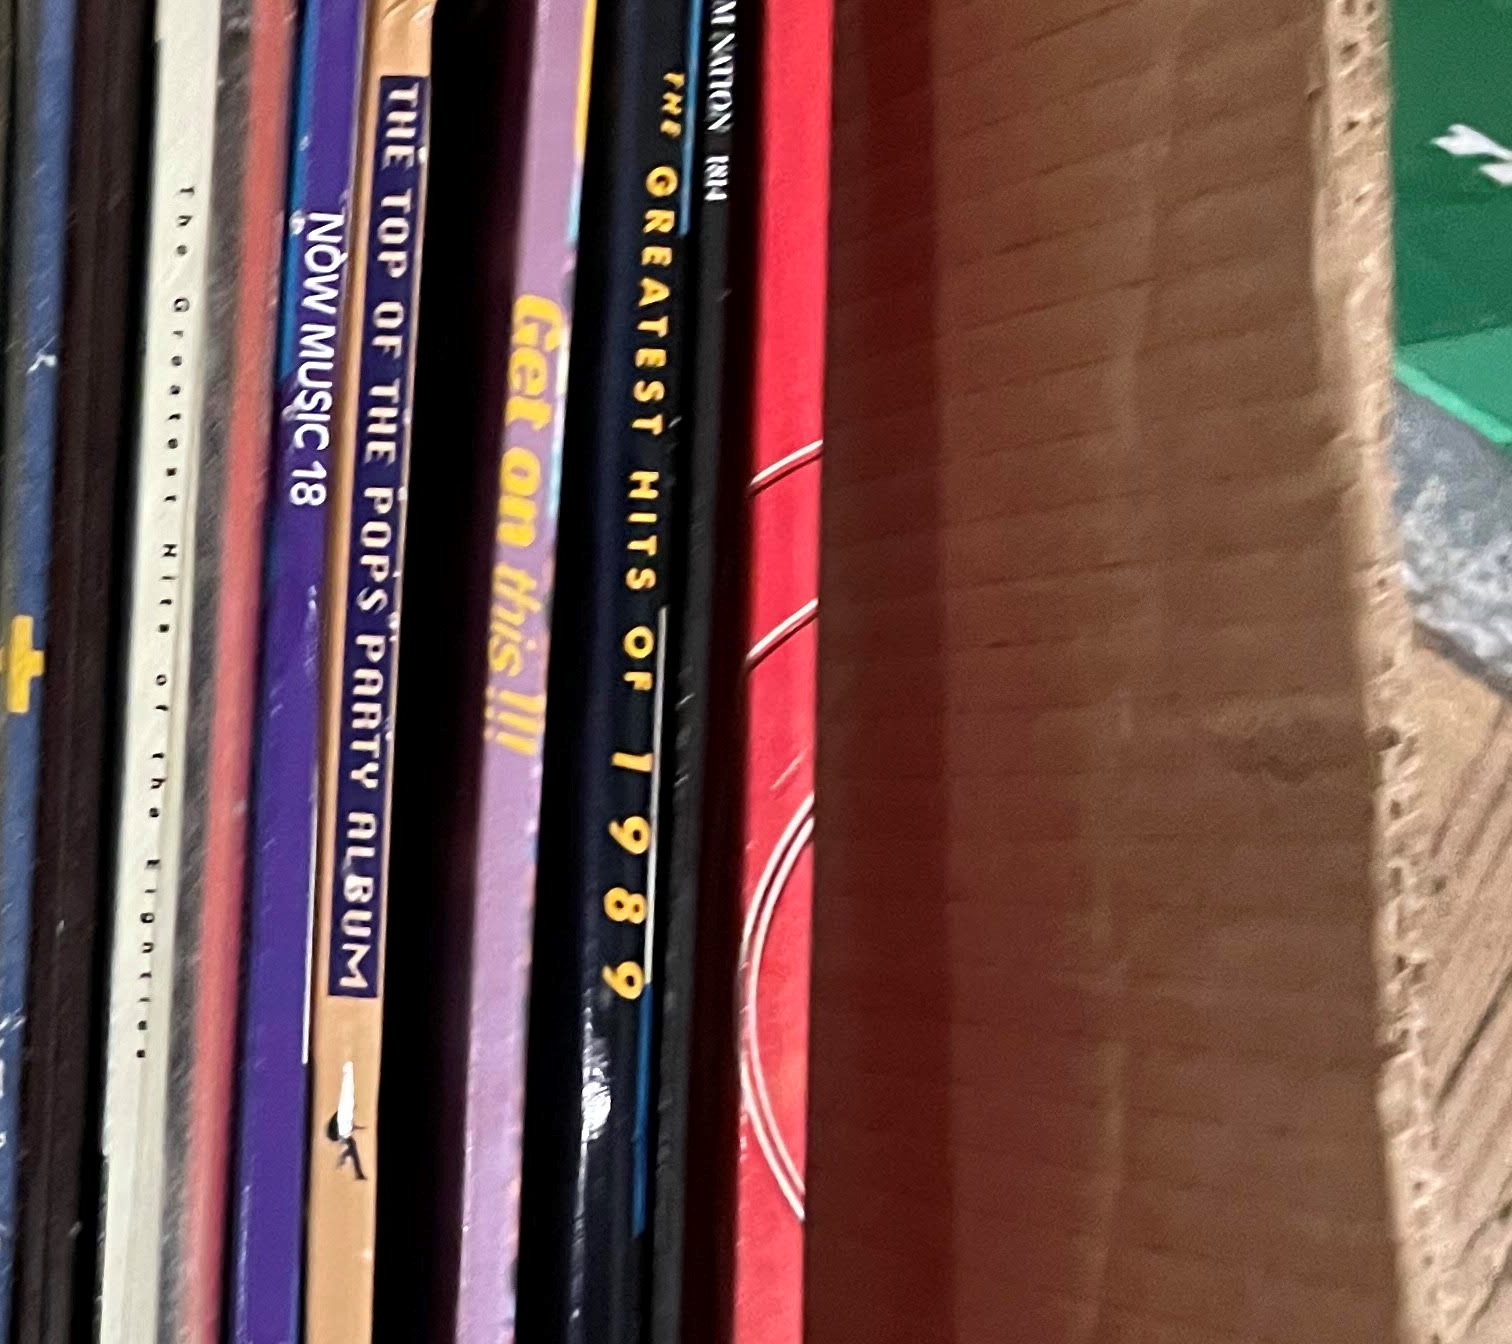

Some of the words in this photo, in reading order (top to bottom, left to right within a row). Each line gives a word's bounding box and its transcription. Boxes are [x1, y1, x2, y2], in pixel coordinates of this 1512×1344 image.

[382, 82, 423, 170] THE
[659, 71, 687, 140] THE
[705, 33, 737, 132] NATION
[174, 185, 196, 258] The
[302, 212, 346, 313] NOW
[375, 188, 414, 279] TOP
[371, 301, 405, 358] OF
[630, 166, 680, 437] GREATEST
[162, 297, 191, 505] Greatest
[290, 323, 336, 450] MUSIC
[505, 293, 564, 430] Get
[364, 379, 402, 464] THE
[290, 460, 327, 506] 18
[501, 446, 544, 548] on
[625, 469, 660, 592] HITS
[156, 542, 179, 635] Hits
[357, 487, 398, 613] POPS
[487, 562, 542, 677] this
[622, 625, 654, 692] OF
[152, 673, 171, 714] of
[349, 633, 388, 789] PARTY
[147, 752, 167, 819] the
[338, 812, 377, 990] ALBUM
[600, 750, 654, 1001] 1989
[135, 859, 163, 1060] Eighties
